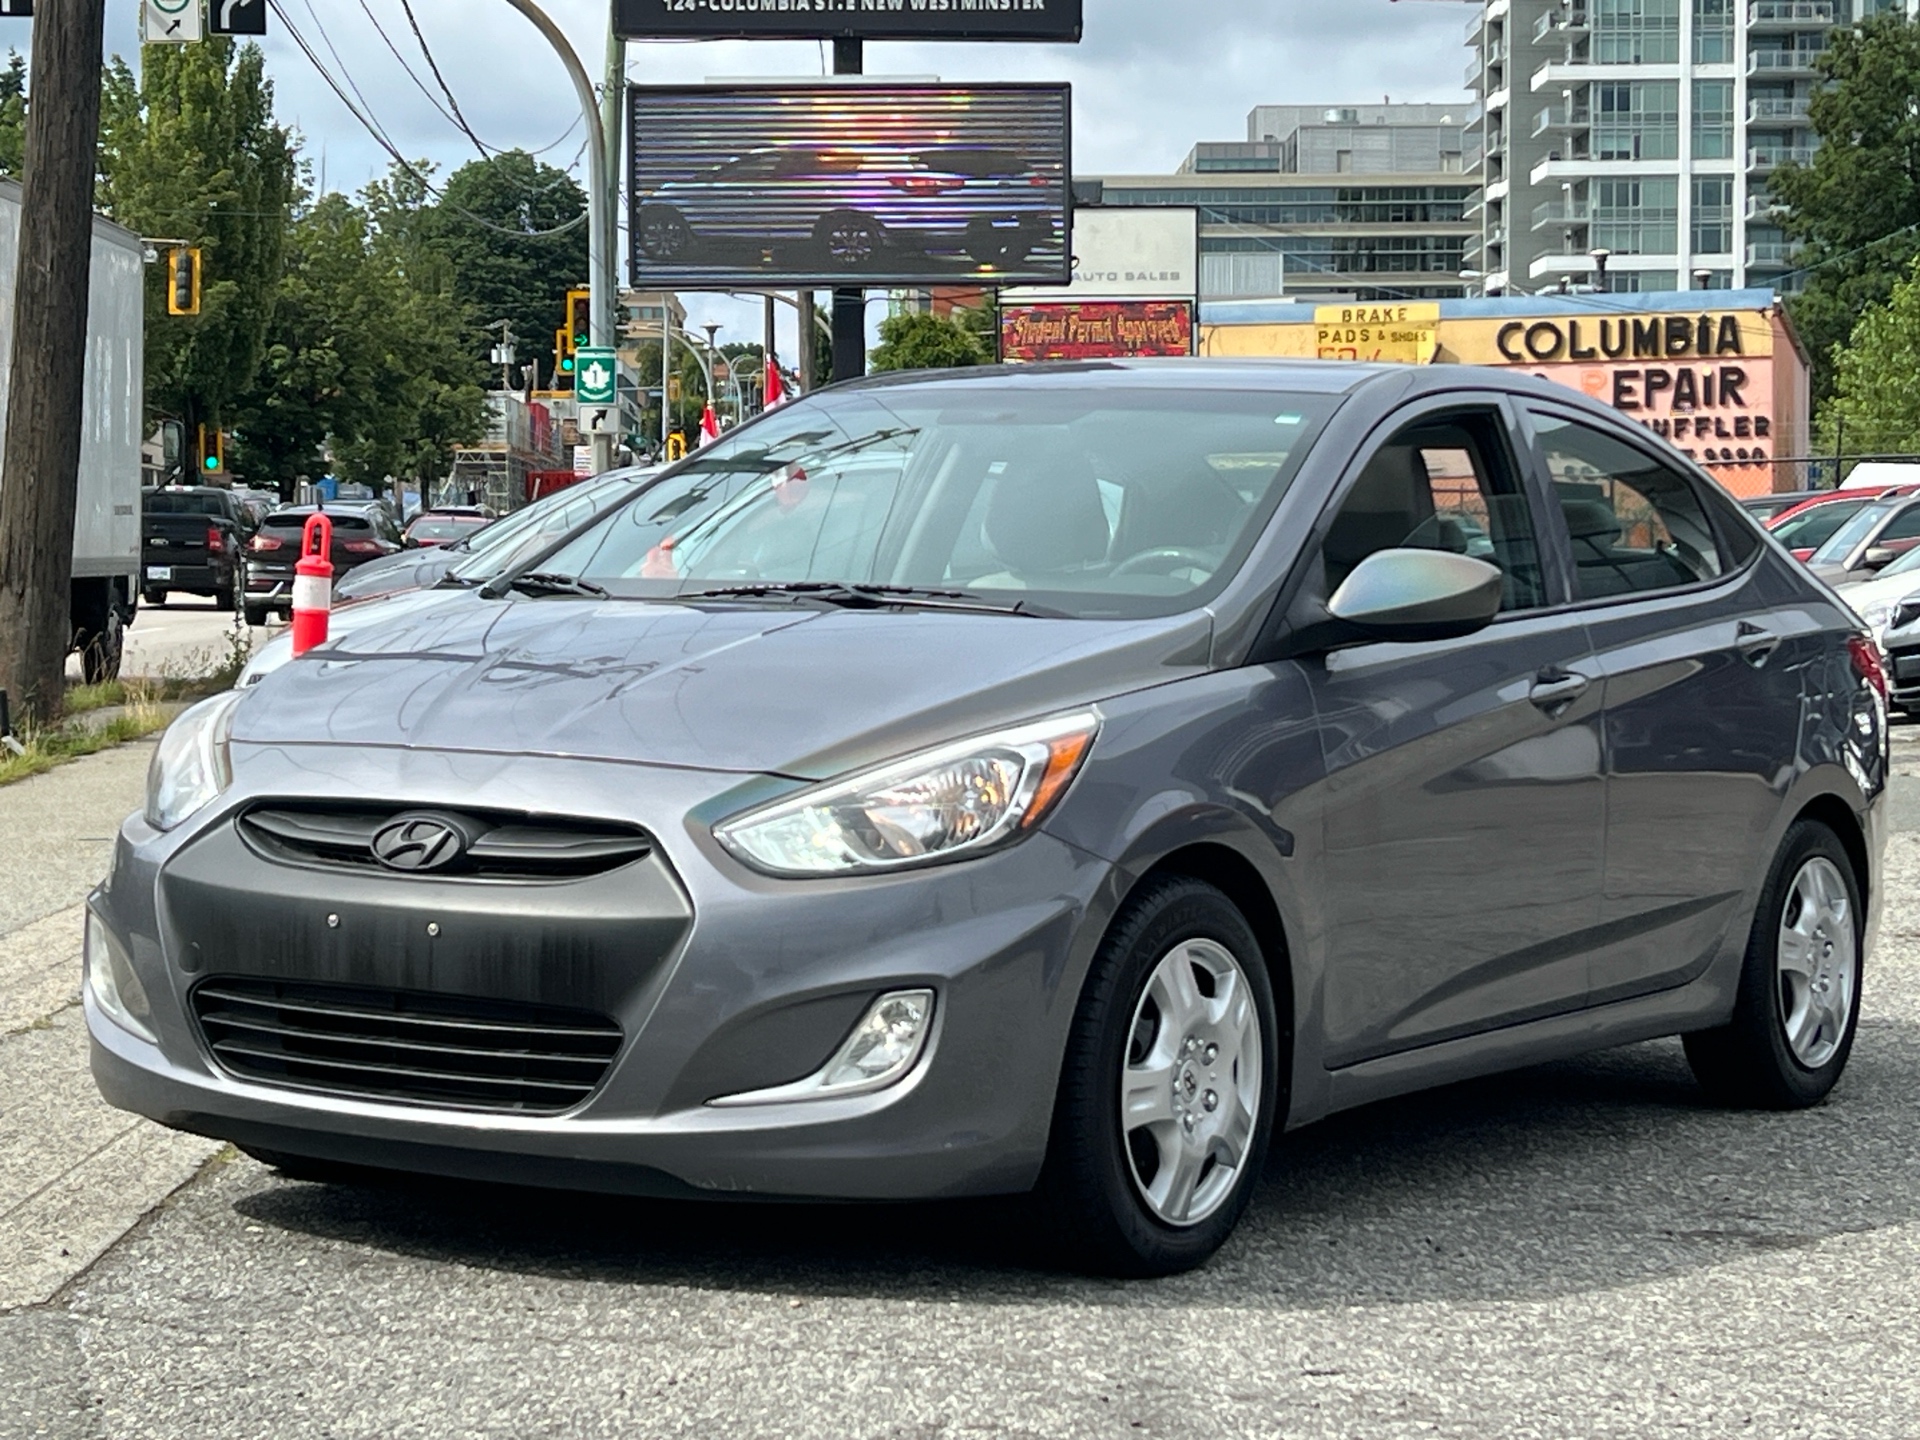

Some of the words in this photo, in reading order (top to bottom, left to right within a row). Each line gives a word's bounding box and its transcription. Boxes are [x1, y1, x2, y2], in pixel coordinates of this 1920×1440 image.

[860, 0, 901, 11] NEW
[909, 0, 1045, 10] WESTMINSTER
[1073, 272, 1118, 282] AUTO
[1124, 271, 1181, 281] SALES
[1341, 307, 1408, 324] BRAKE
[1318, 328, 1370, 344] PADS
[592, 370, 598, 384] 1
[1641, 416, 1770, 439] UFFLER
